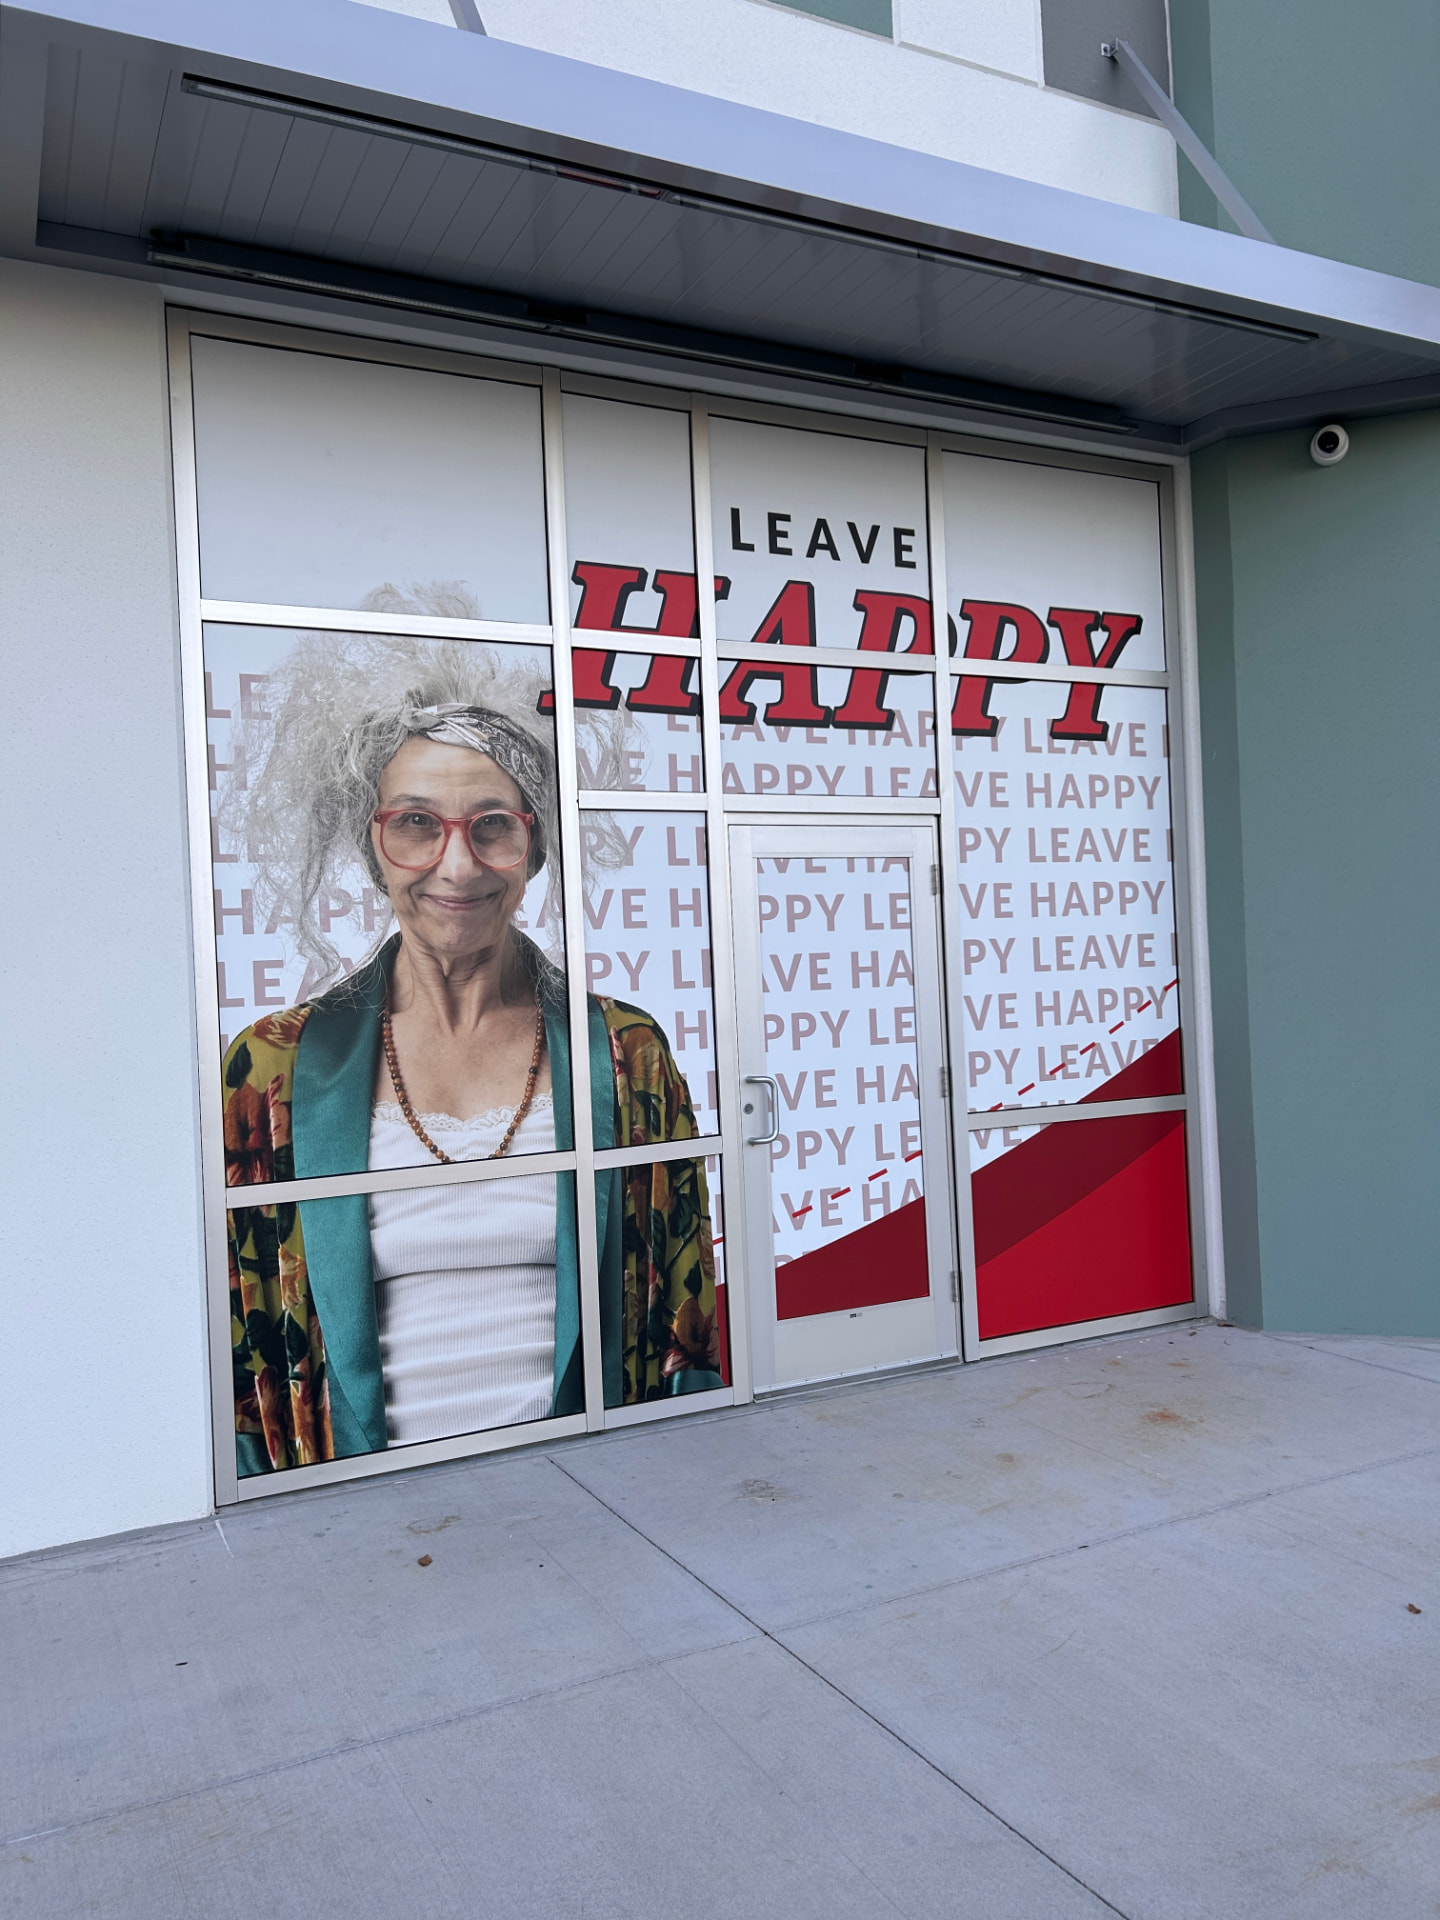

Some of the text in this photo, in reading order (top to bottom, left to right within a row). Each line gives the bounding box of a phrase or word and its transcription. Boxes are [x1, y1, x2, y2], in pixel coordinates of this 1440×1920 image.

[730, 507, 917, 569] LEAVE
[536, 560, 1144, 741] HAPPY
[1026, 772, 1162, 810] HAPPY
[1028, 827, 1151, 863] LEAVE
[214, 887, 391, 935] HAPP
[669, 888, 845, 933] HPPY
[863, 882, 1013, 931] LEVE
[1030, 880, 1166, 918] HAPPY
[850, 938, 1016, 988] HAPY
[1032, 933, 1156, 972] LEAVE
[675, 985, 1168, 1052] HPPY LEVE HAPPY
[856, 1048, 1021, 1104] HAPY
